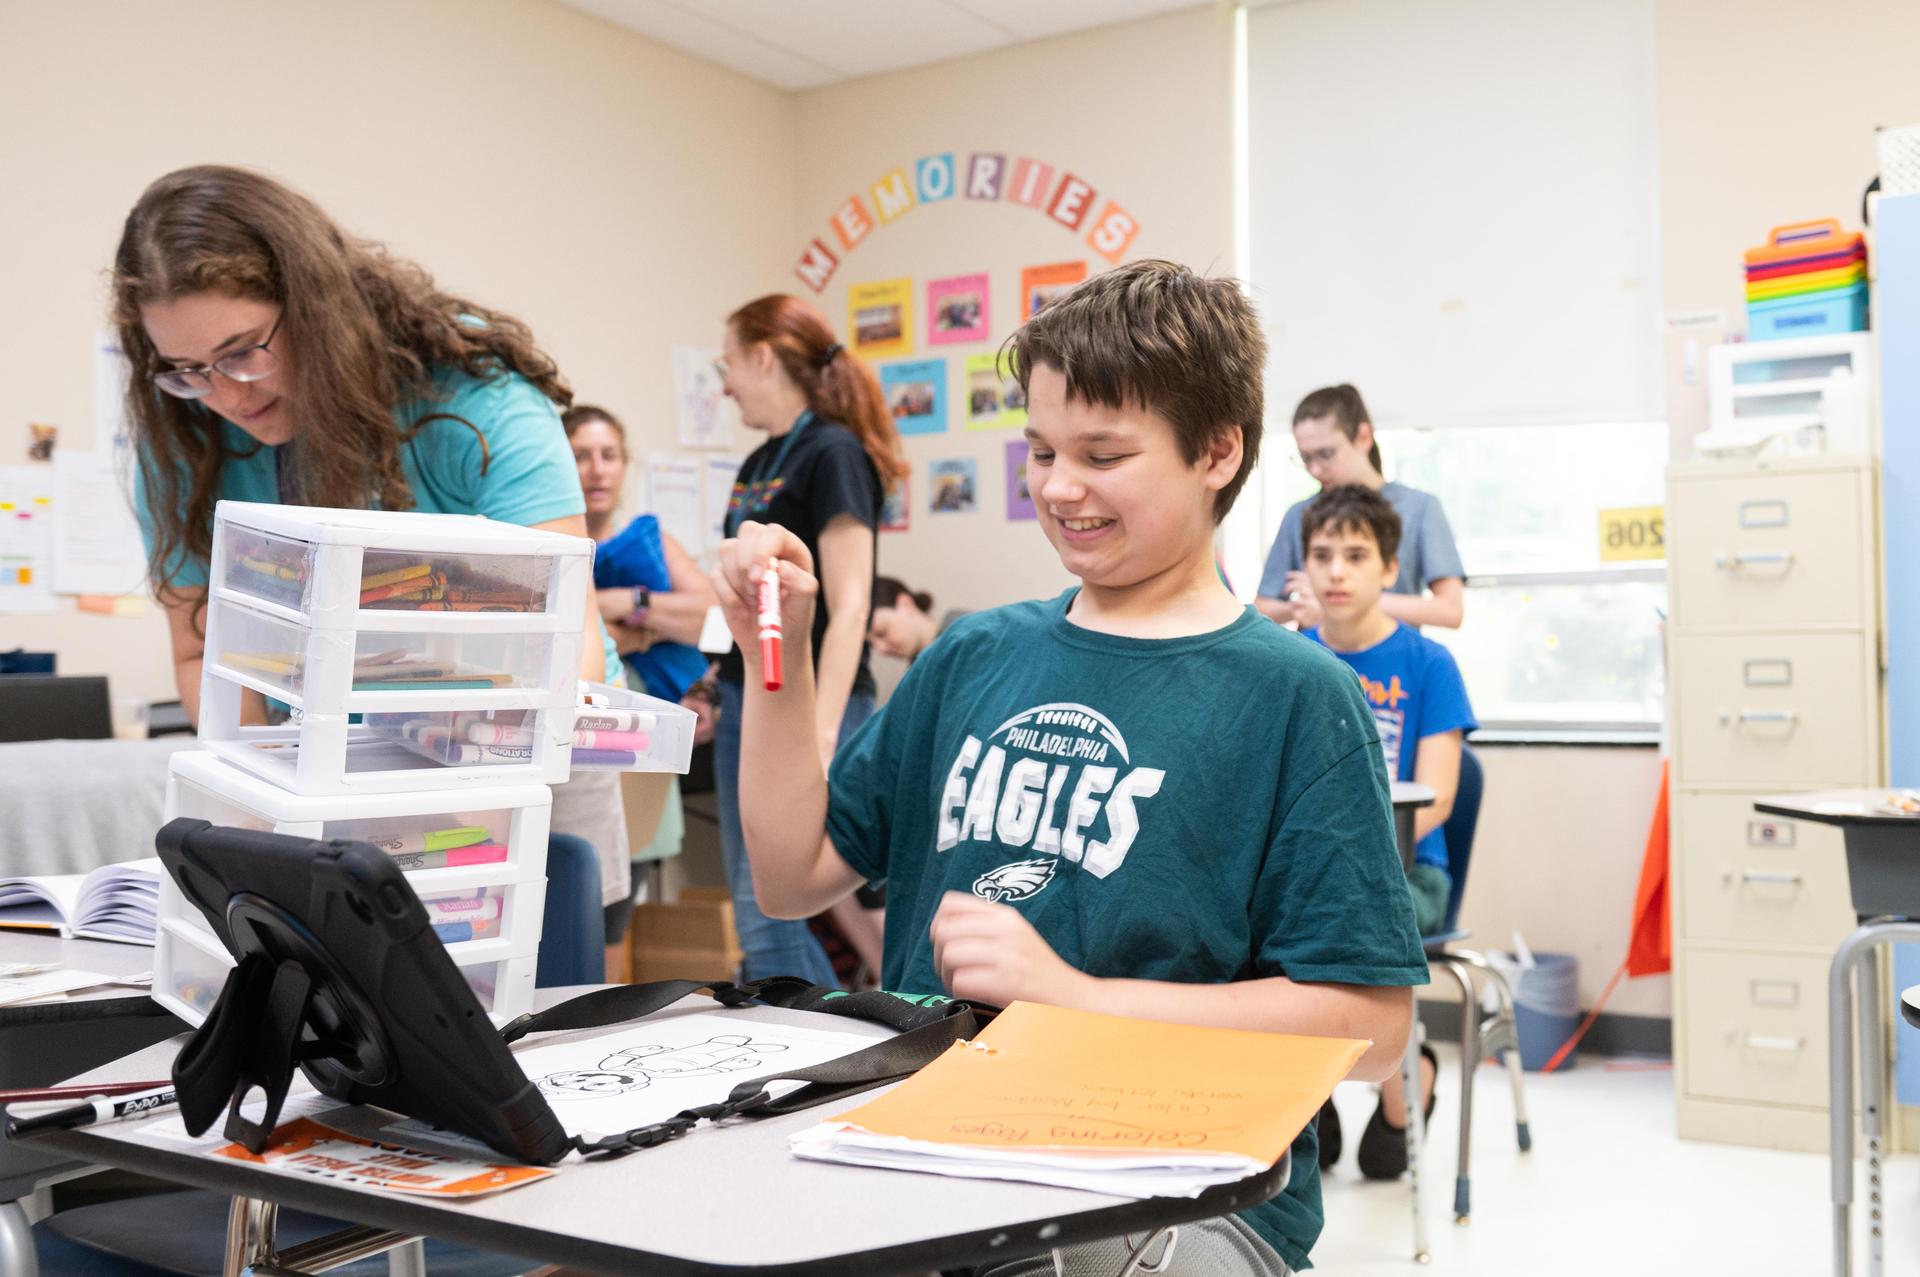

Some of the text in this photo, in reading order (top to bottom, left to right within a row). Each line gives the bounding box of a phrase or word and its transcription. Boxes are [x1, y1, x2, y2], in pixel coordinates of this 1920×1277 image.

[797, 155, 1133, 288] MEMORIES
[1004, 727, 1109, 762] PHILADELPHIA
[936, 734, 1167, 880] EAGLES
[122, 1096, 159, 1115] EXPO
